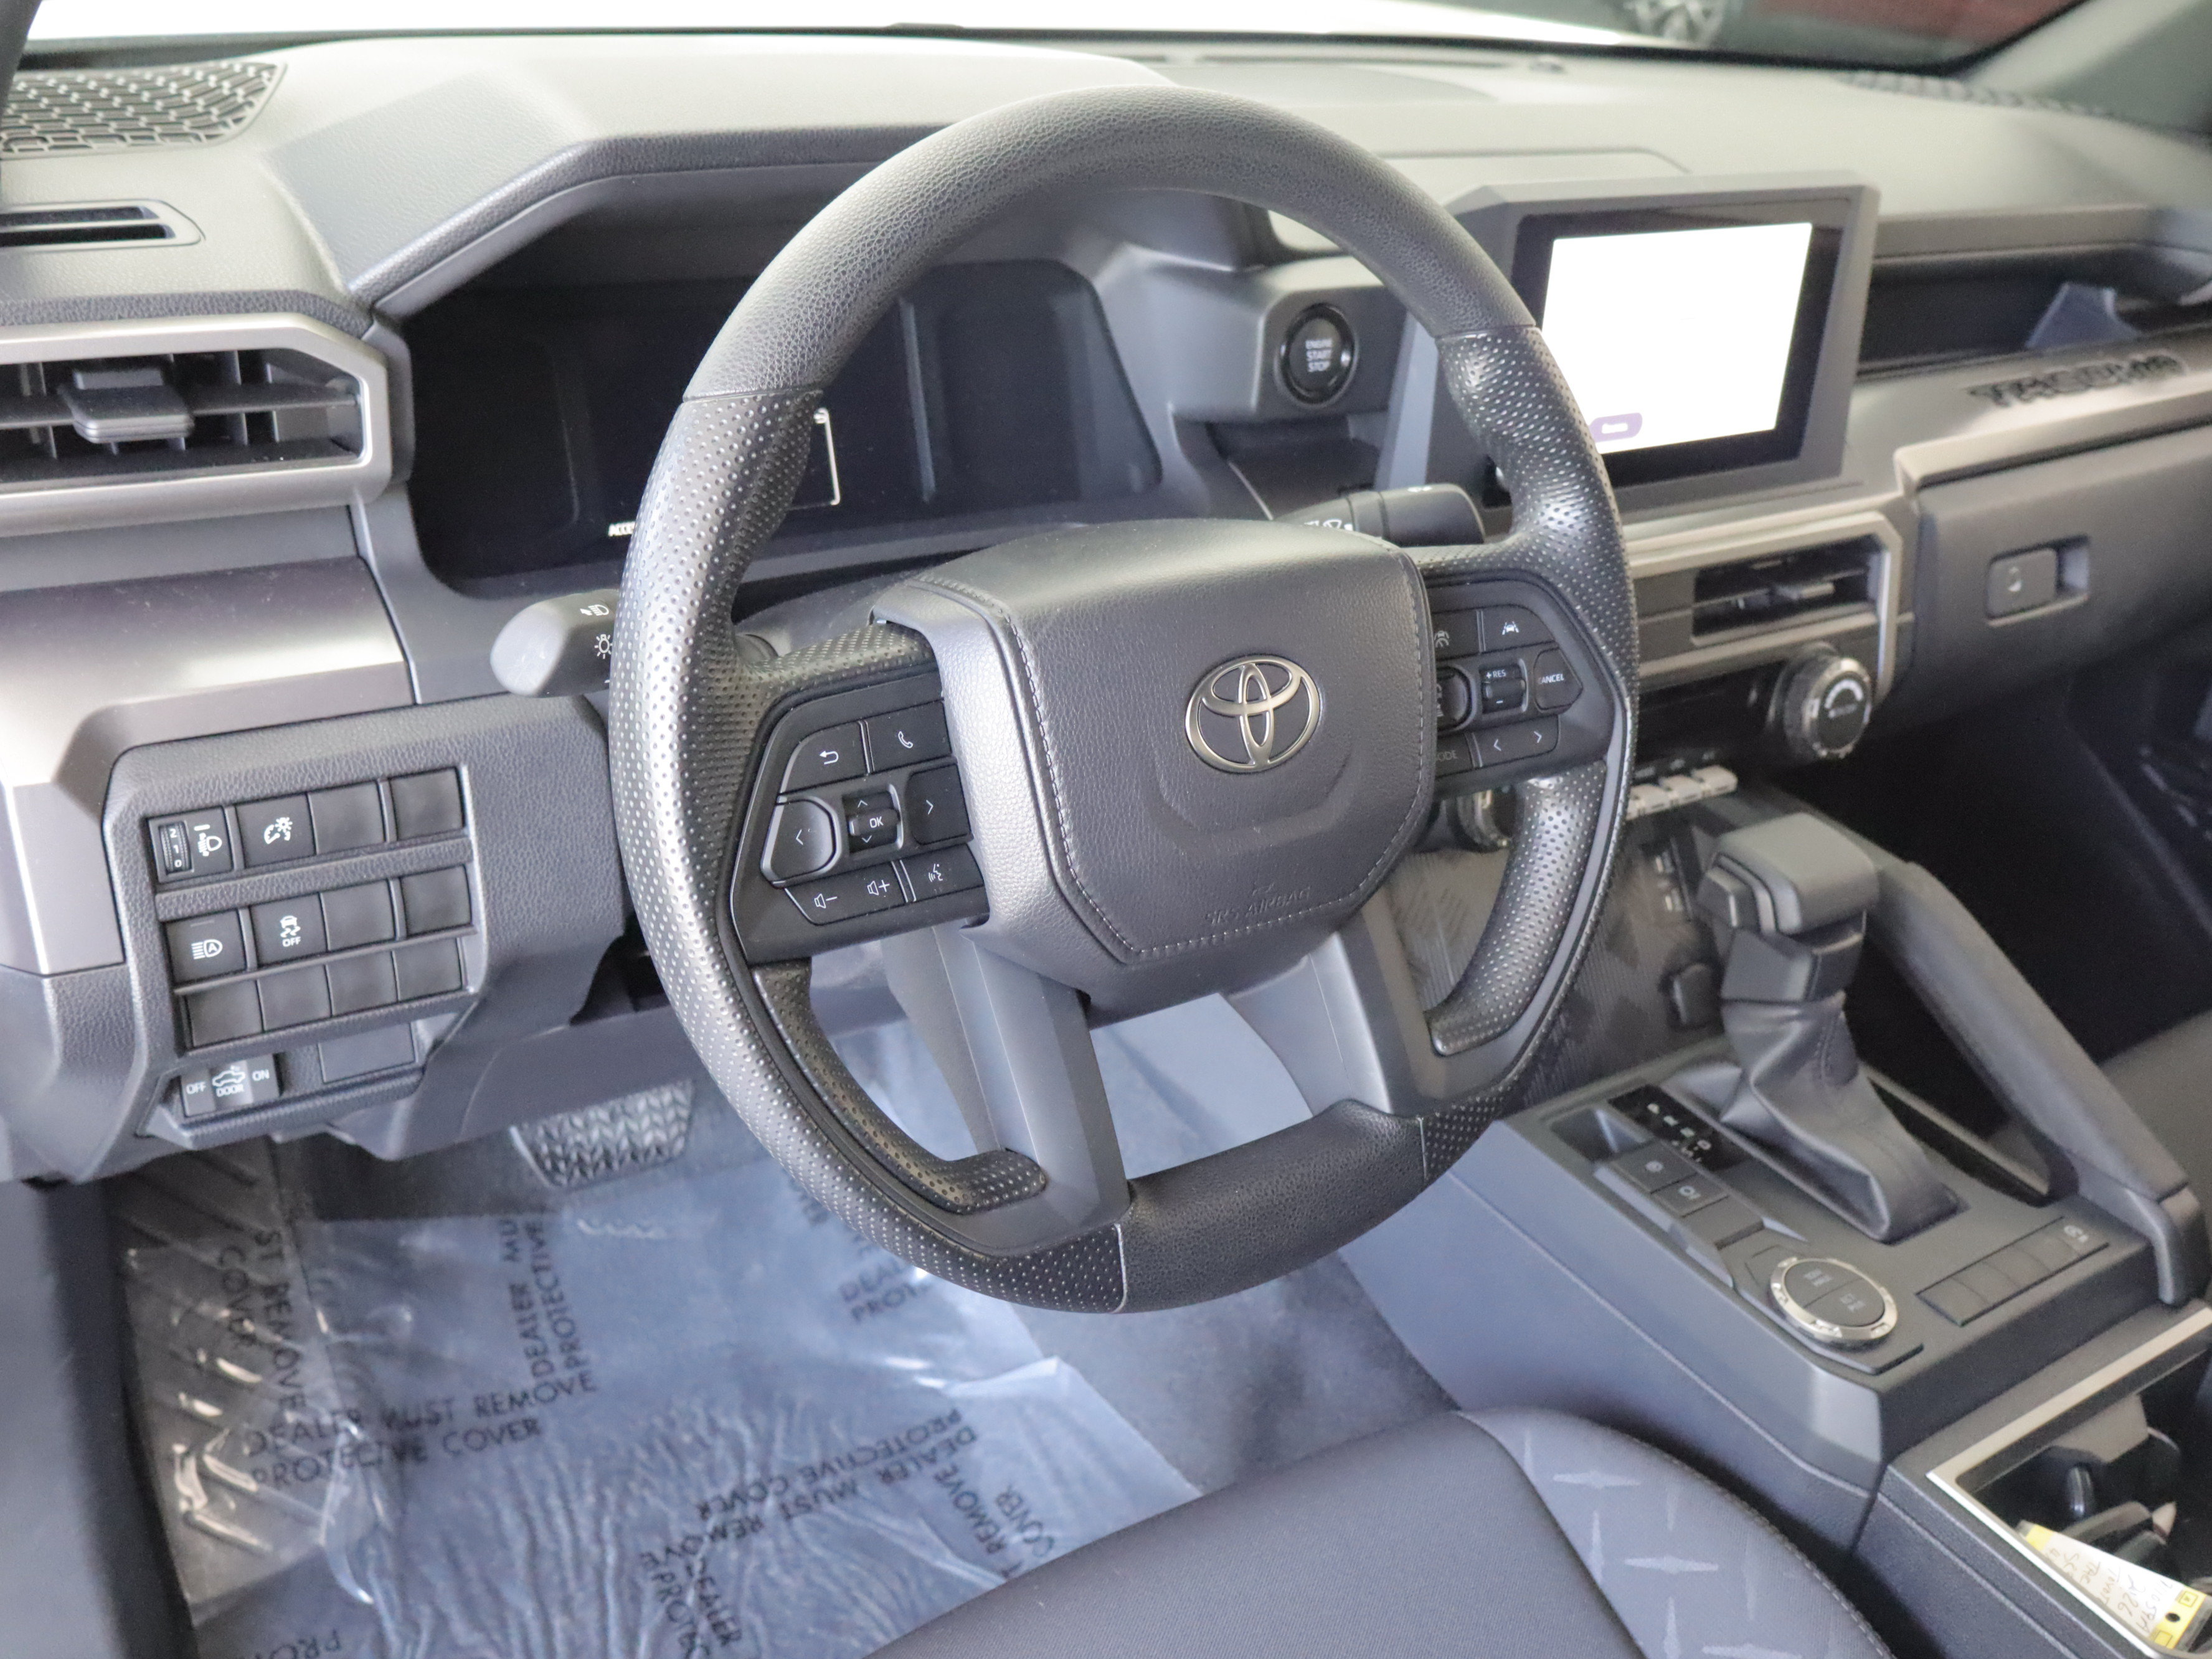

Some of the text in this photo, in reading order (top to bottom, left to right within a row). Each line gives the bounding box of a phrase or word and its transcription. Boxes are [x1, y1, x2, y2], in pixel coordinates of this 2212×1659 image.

[1538, 673, 1565, 684] CANCEL
[869, 816, 884, 828] OK
[169, 828, 177, 838] 2
[173, 844, 179, 854] 1
[282, 936, 301, 947] OFF
[252, 1069, 270, 1082] ON
[186, 1081, 206, 1095] OFF
[216, 1084, 245, 1097] DOOR
[473, 1372, 596, 1419] REMOVE
[442, 1417, 542, 1458] COVER
[798, 1408, 962, 1485] PROTECTIVE
[876, 1425, 977, 1486] DEALER
[778, 1478, 859, 1521] MUST
[934, 1464, 1006, 1554] REMOVE
[995, 1484, 1055, 1558] COVER
